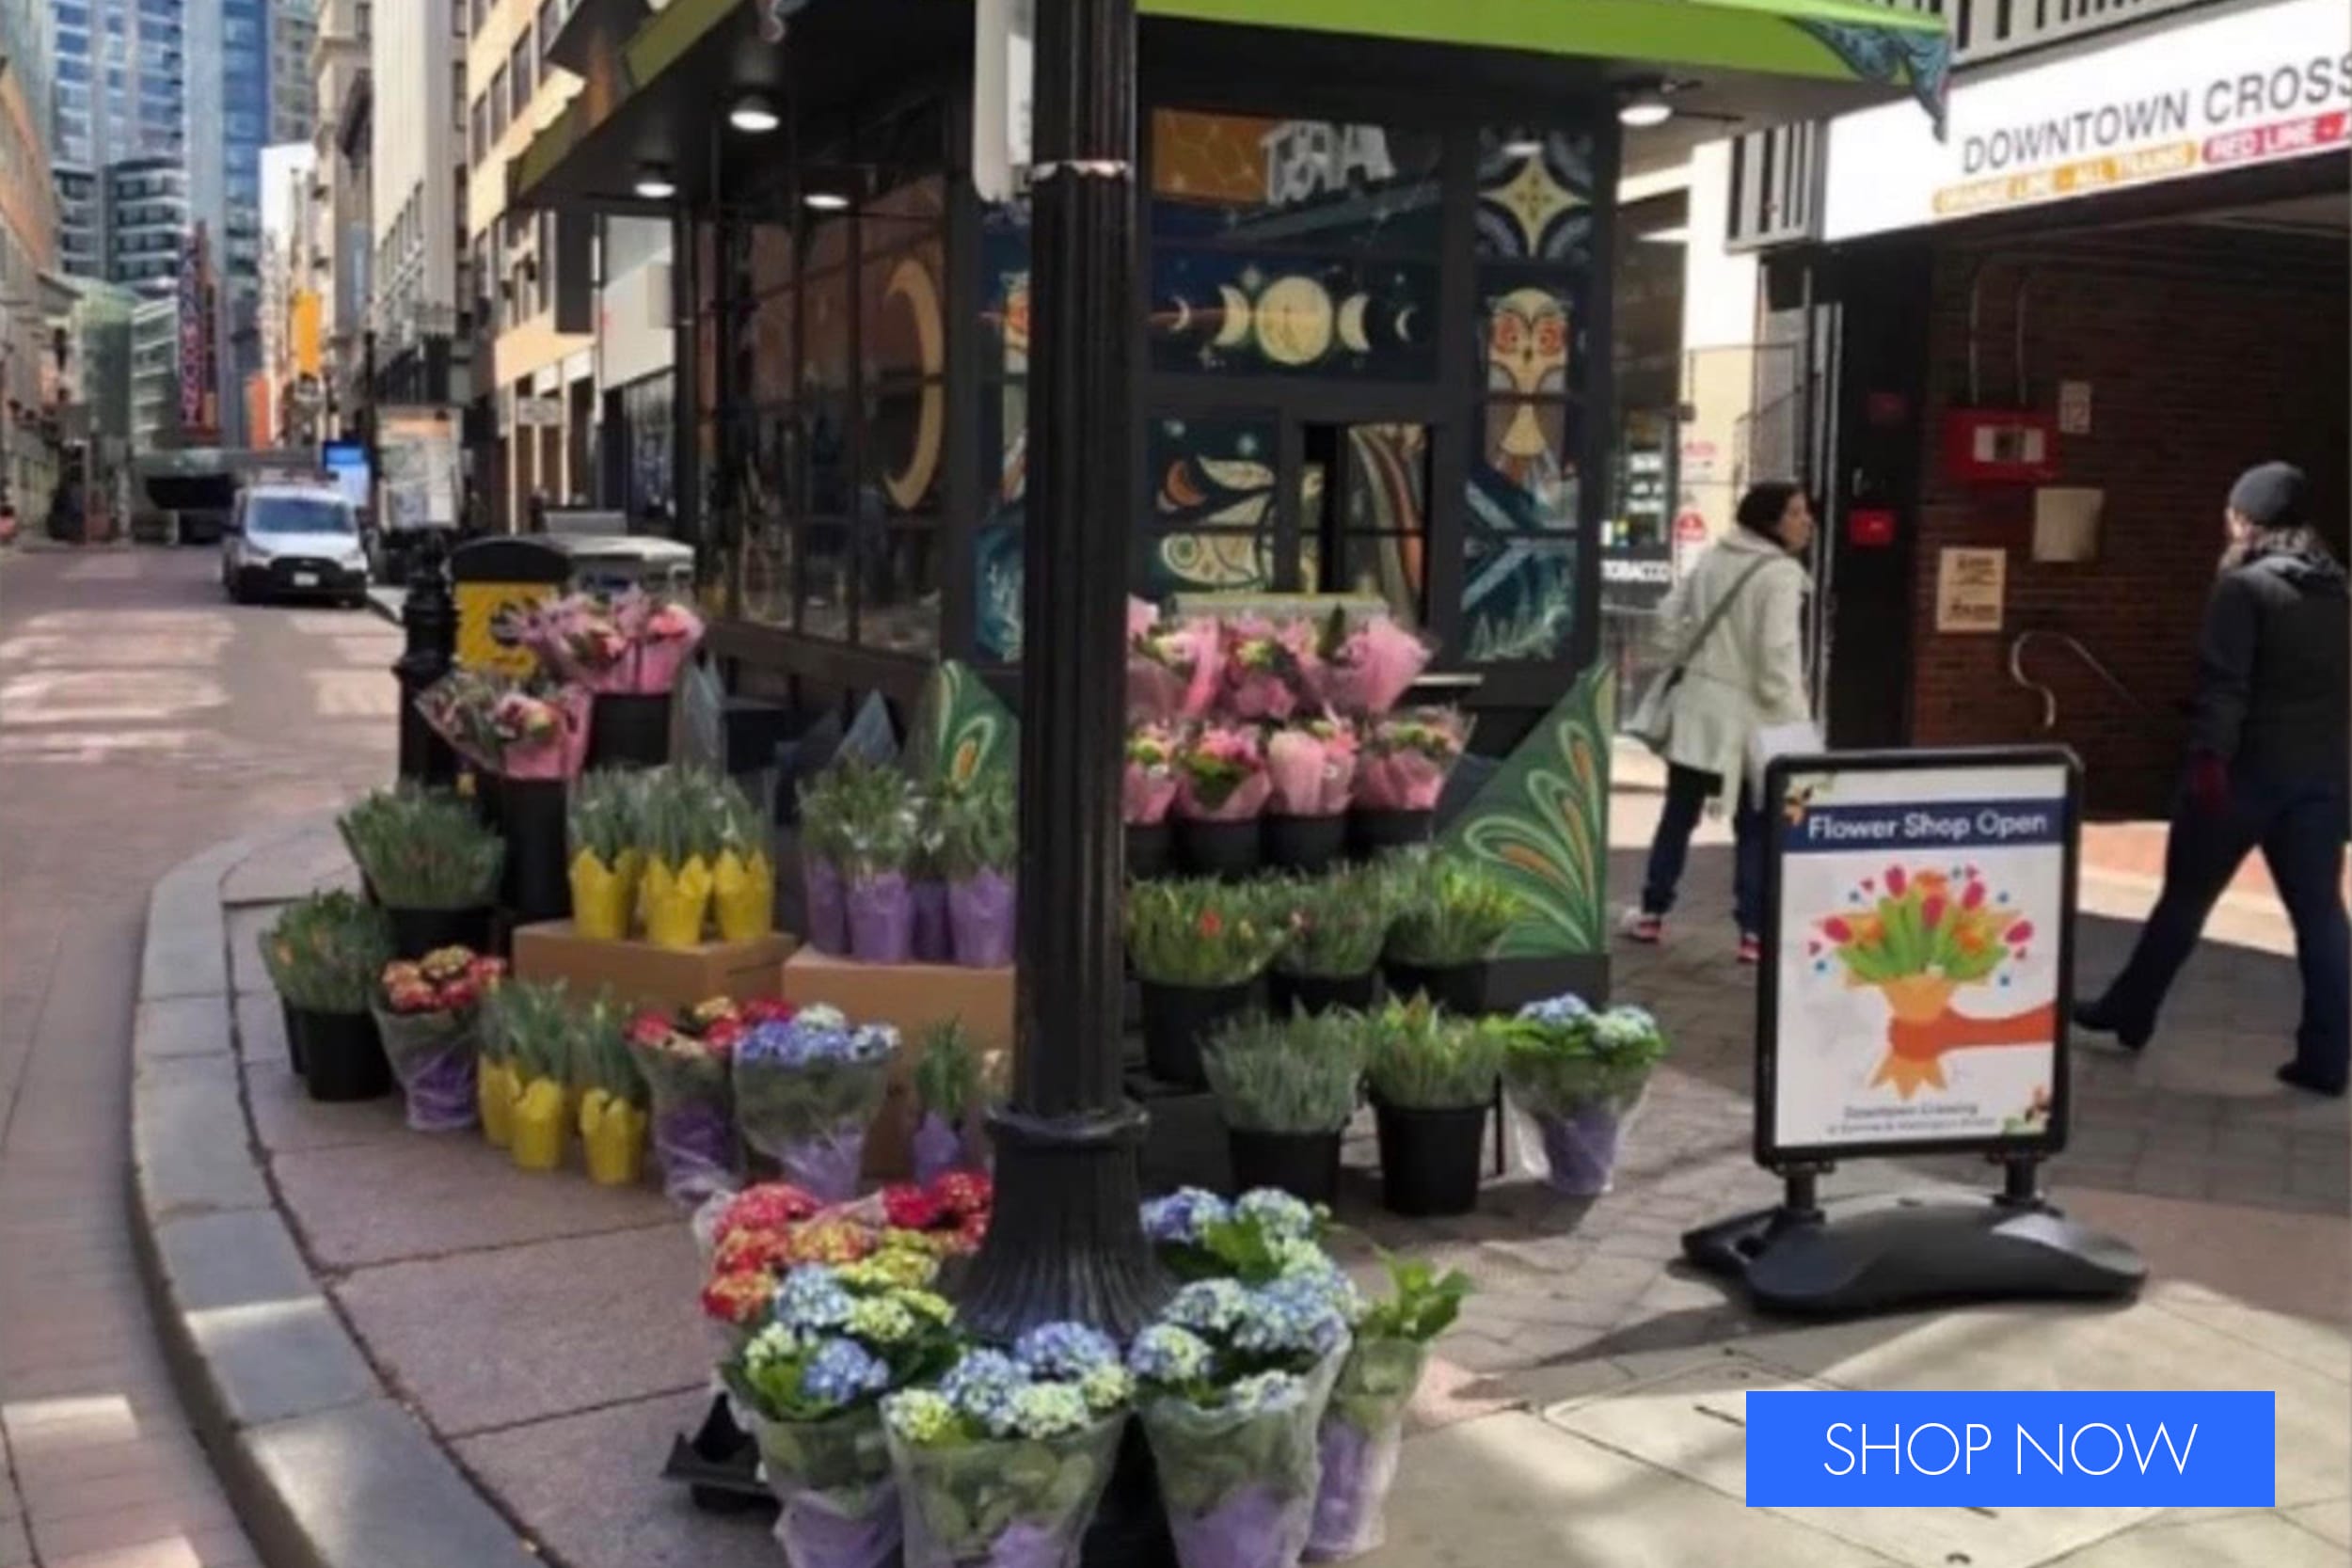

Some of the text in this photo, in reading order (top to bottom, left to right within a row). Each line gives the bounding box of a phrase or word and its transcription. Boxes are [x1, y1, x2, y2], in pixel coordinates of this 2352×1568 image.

[1963, 89, 2188, 174] DOWNTOWN
[2210, 130, 2256, 162] RED
[2263, 119, 2315, 154] LINE
[1808, 809, 2047, 841] Flower Shop Open
